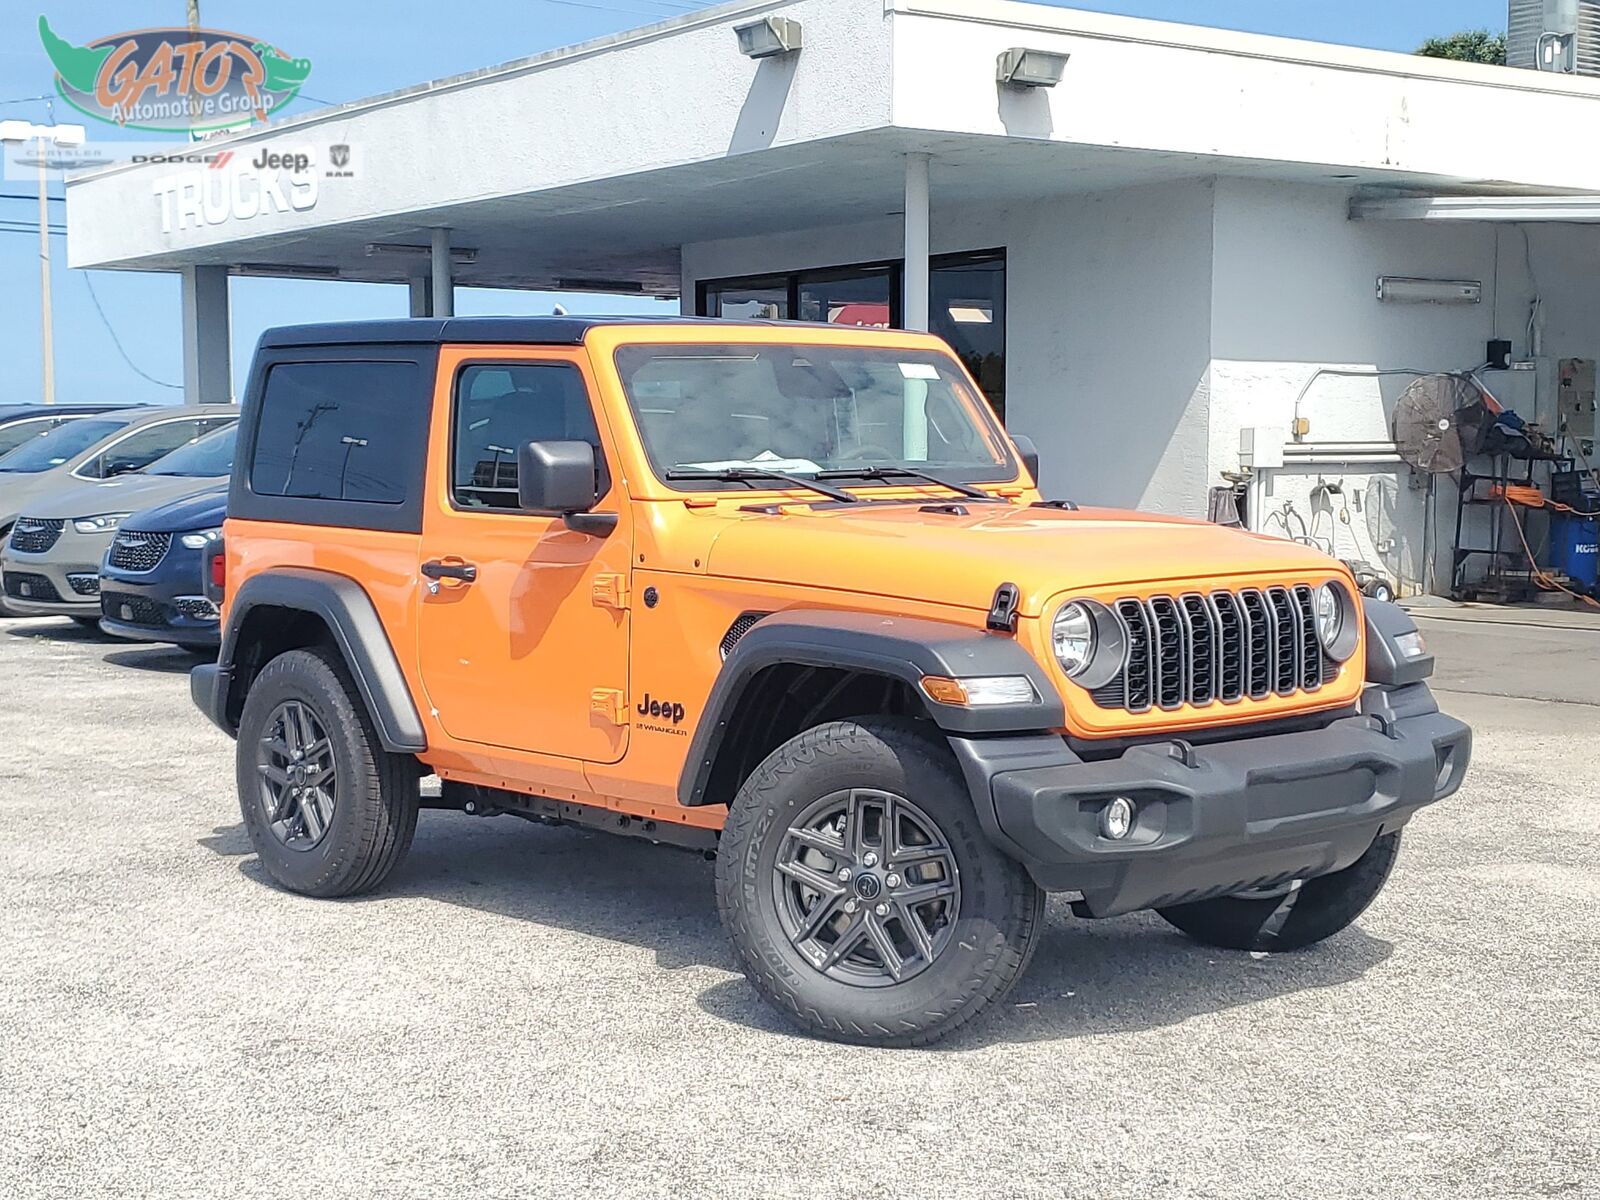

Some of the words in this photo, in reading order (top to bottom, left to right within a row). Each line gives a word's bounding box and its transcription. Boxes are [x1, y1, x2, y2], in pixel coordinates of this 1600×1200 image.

[153, 147, 318, 234] TRUCKS
[637, 693, 685, 724] Jeep
[643, 723, 688, 737] WRANGLER
